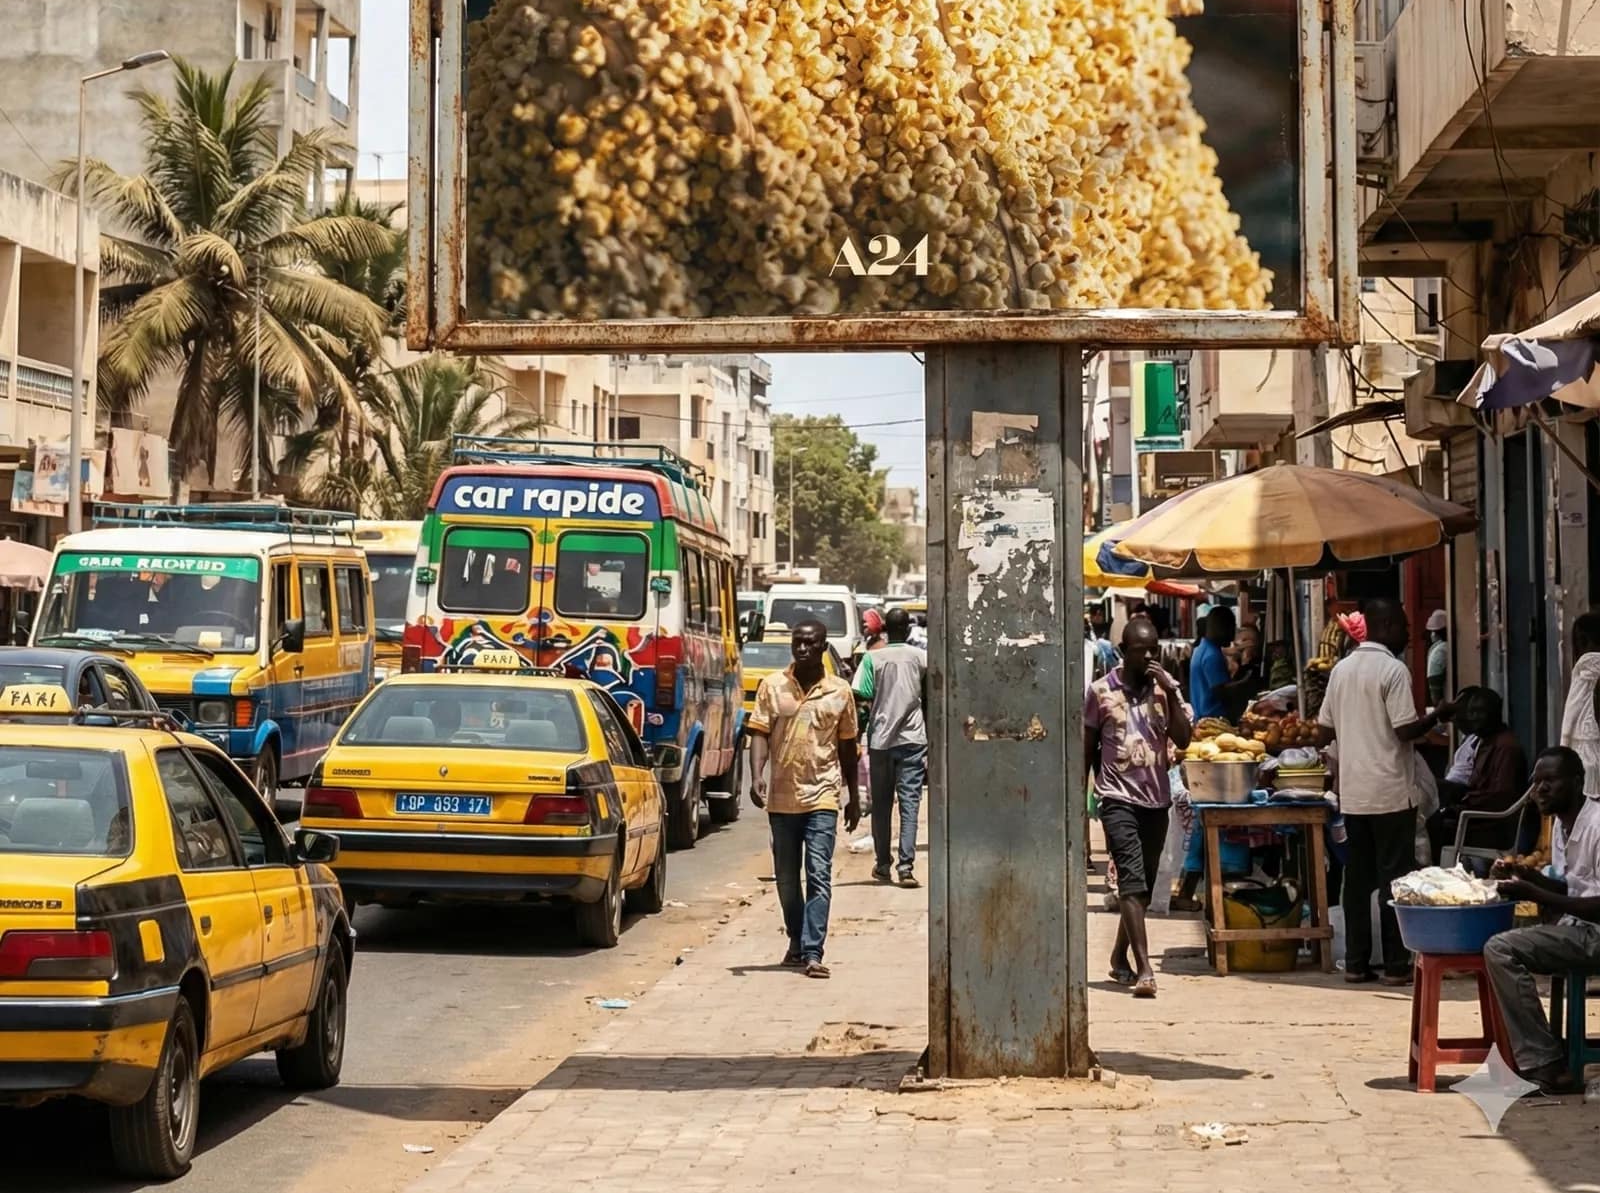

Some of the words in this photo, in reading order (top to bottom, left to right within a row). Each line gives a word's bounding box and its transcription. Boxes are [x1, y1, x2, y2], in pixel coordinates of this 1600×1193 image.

[829, 233, 933, 277] A24
[454, 485, 514, 509] car
[523, 483, 645, 518] rapide
